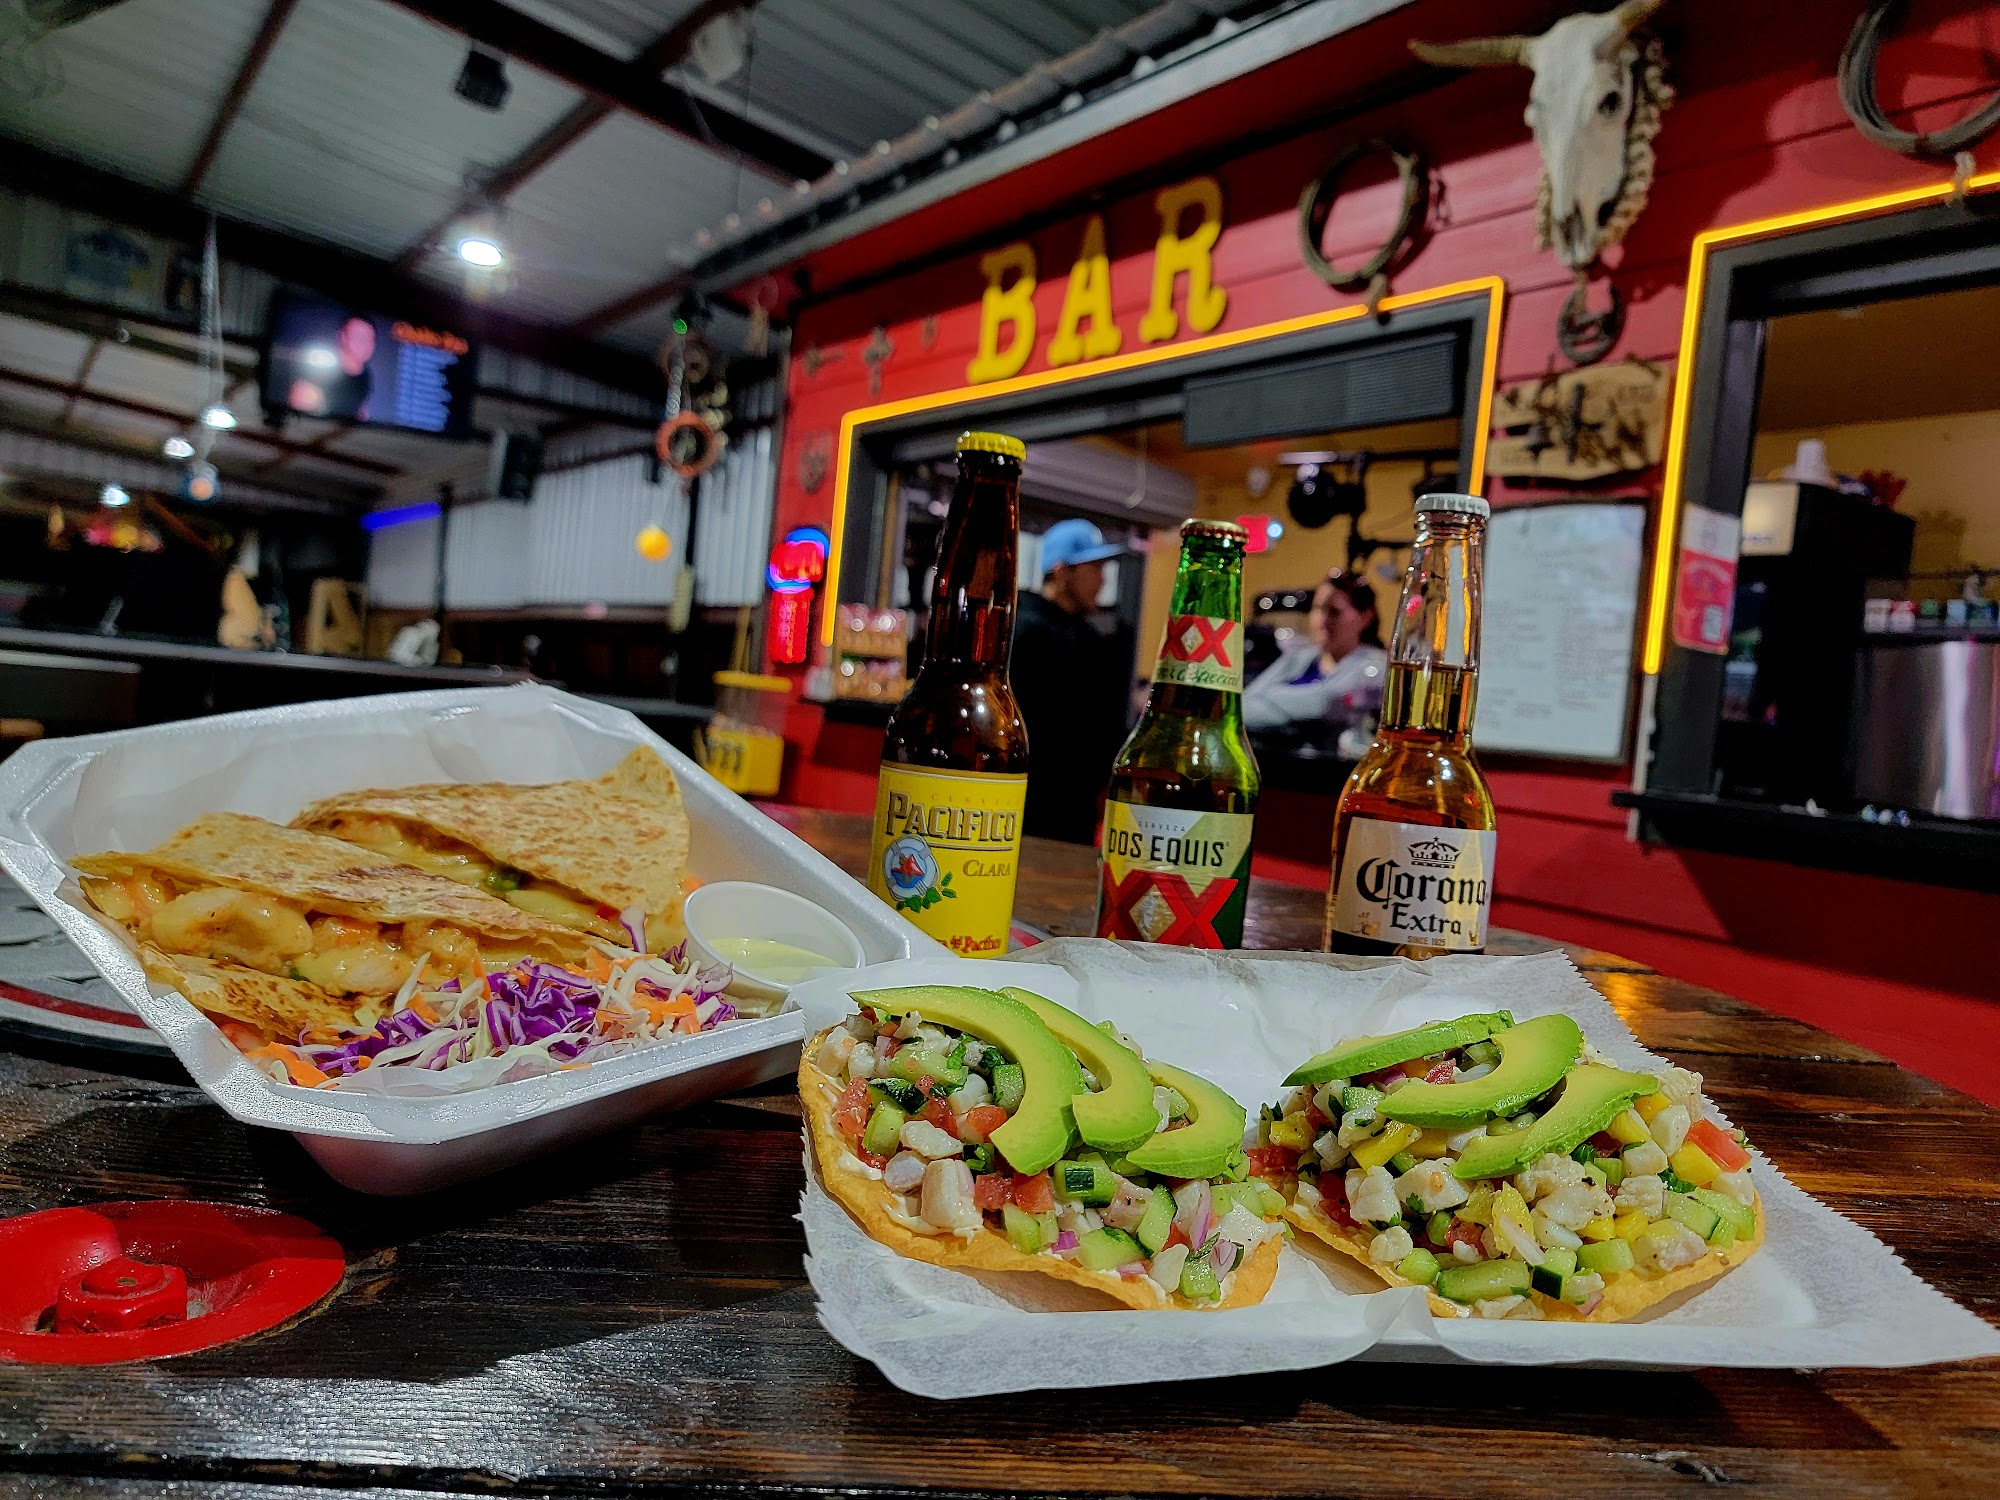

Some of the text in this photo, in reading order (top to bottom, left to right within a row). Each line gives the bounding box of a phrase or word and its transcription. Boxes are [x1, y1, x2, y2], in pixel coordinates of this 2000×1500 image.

[967, 176, 1227, 386] BAR
[1159, 613, 1236, 668] XX
[886, 790, 1018, 842] PACIFICO
[1138, 820, 1186, 832] CERVEZA
[962, 859, 1011, 877] CLARA
[1108, 827, 1225, 867] DOS EQUIS
[1096, 861, 1239, 950] XX
[1356, 857, 1487, 910] Corona
[1390, 901, 1462, 935] Extra
